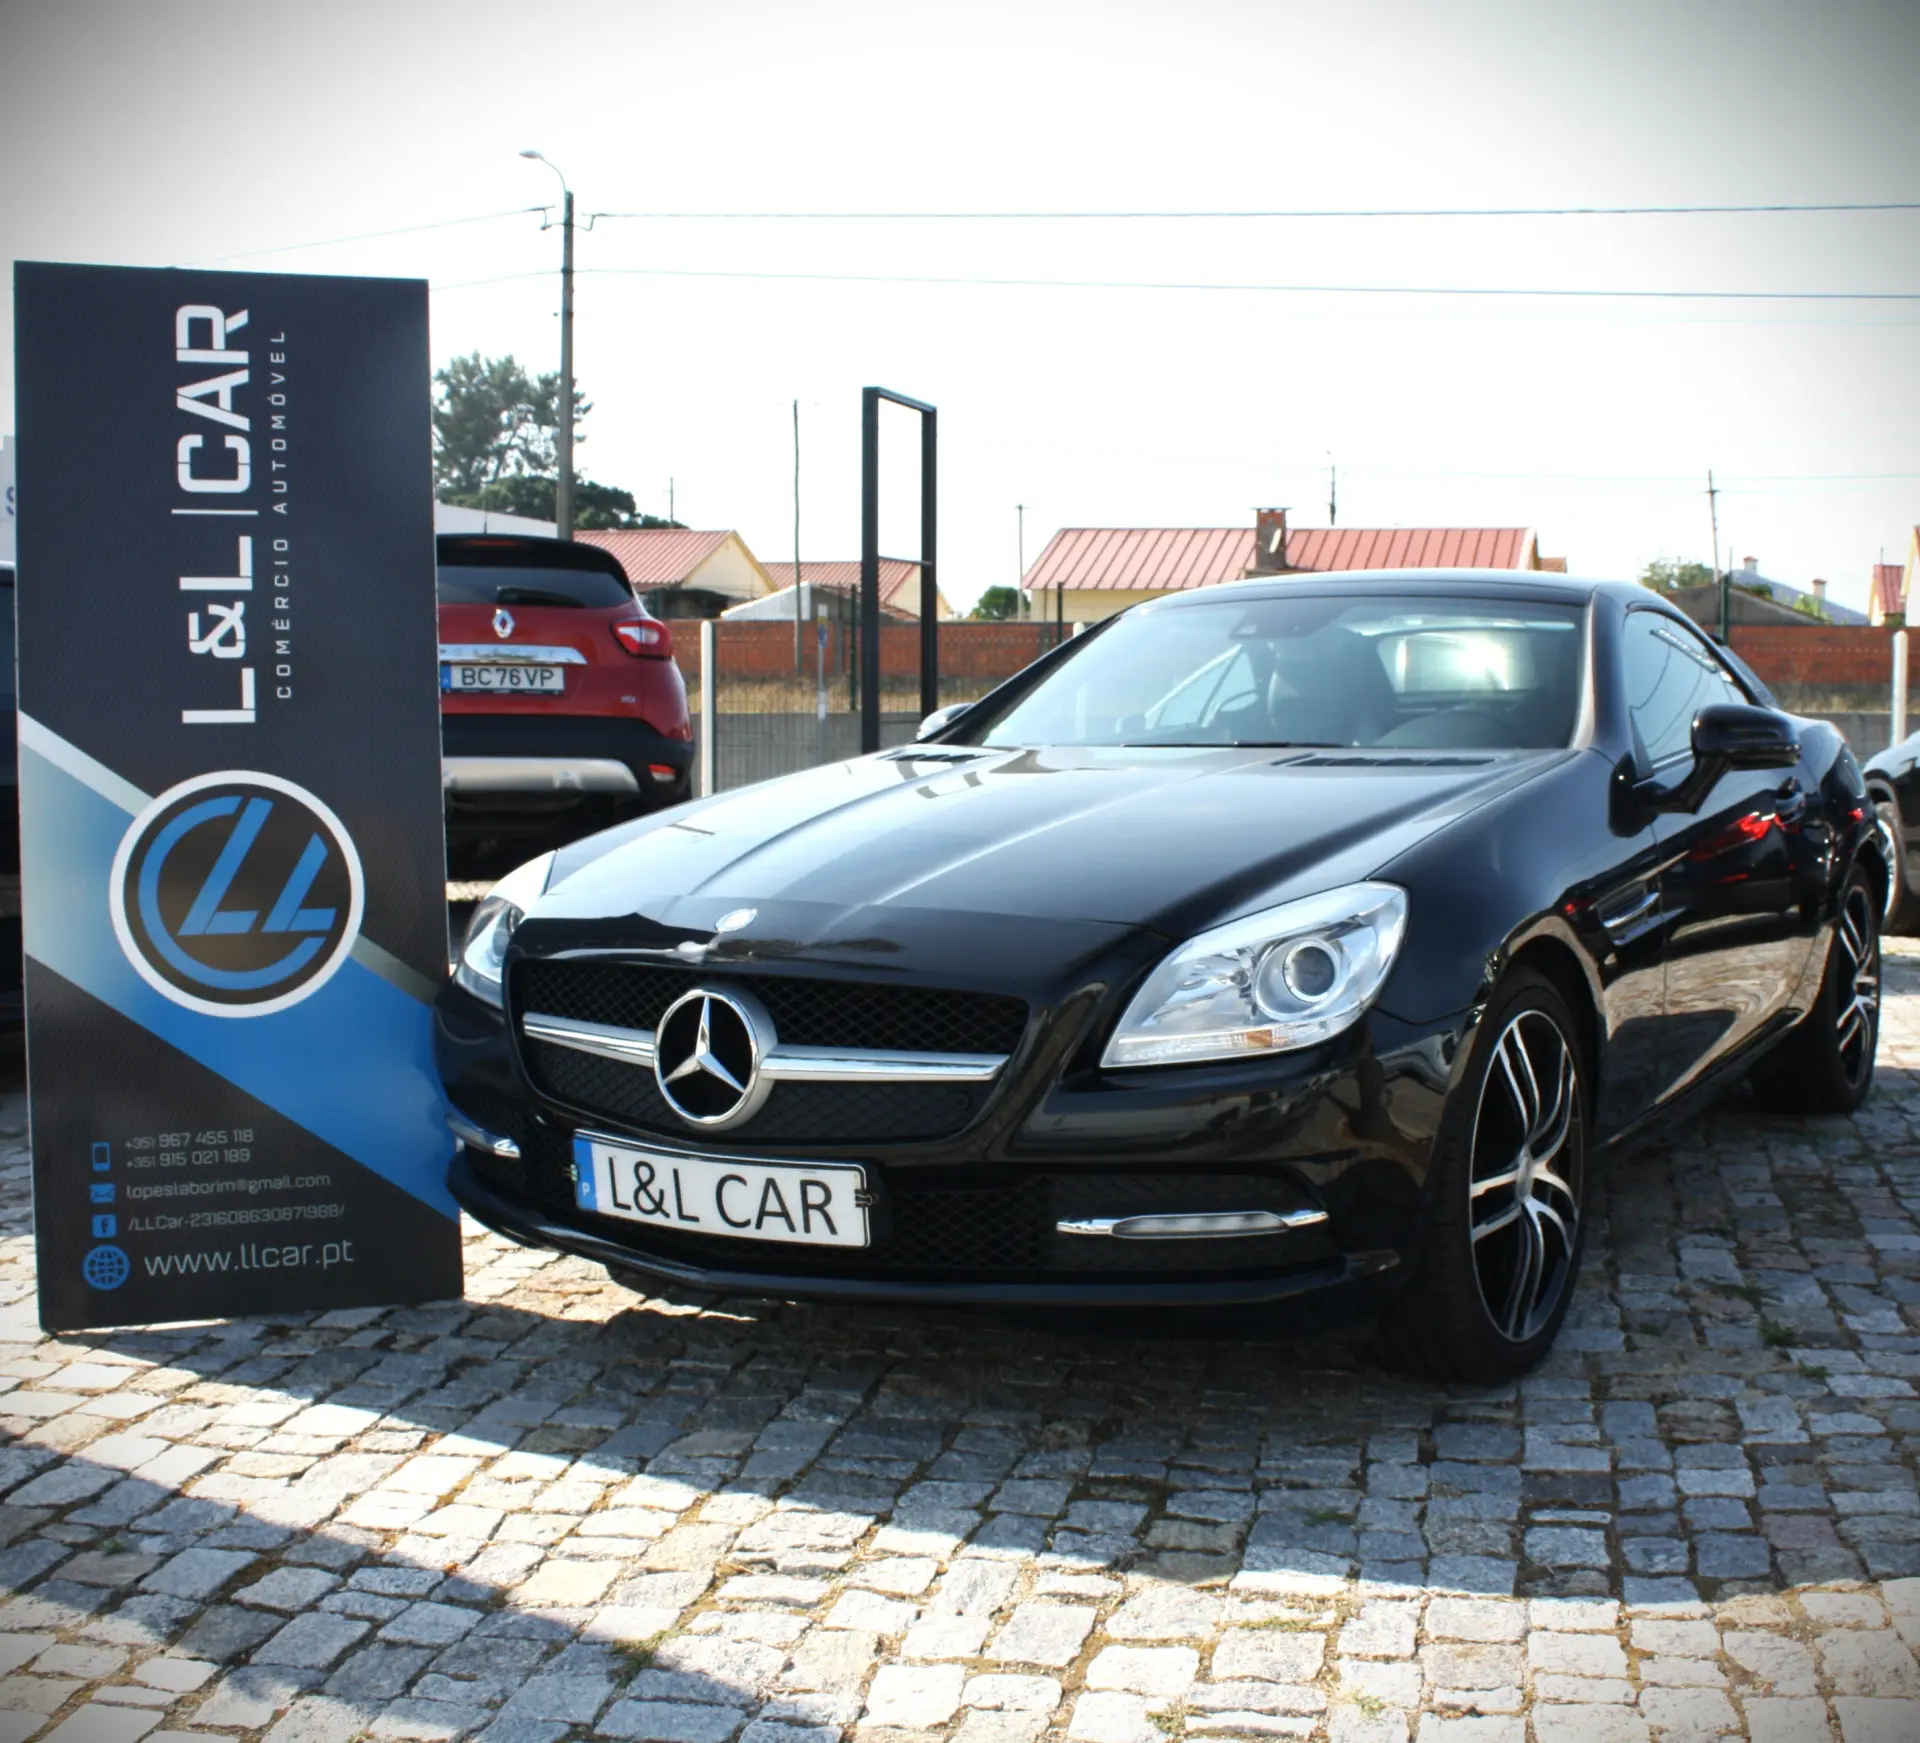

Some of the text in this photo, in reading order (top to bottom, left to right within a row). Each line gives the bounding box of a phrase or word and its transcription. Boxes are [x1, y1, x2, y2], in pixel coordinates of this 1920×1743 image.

[175, 304, 256, 724] L&L CAR
[267, 331, 292, 699] COMÉRCIO AUTOMÓVEL
[461, 667, 554, 687] BC 76 VP
[158, 1131, 191, 1148] 967
[195, 1130, 228, 1145] 455
[232, 1128, 254, 1143] 118
[160, 1151, 187, 1167] 915
[191, 1150, 219, 1165] 021
[223, 1147, 251, 1164] 189
[126, 1174, 331, 1201] lopeslaborim@gmail.com
[607, 1155, 839, 1236] L&L CAR
[143, 1239, 355, 1277] www.llcar.pt
